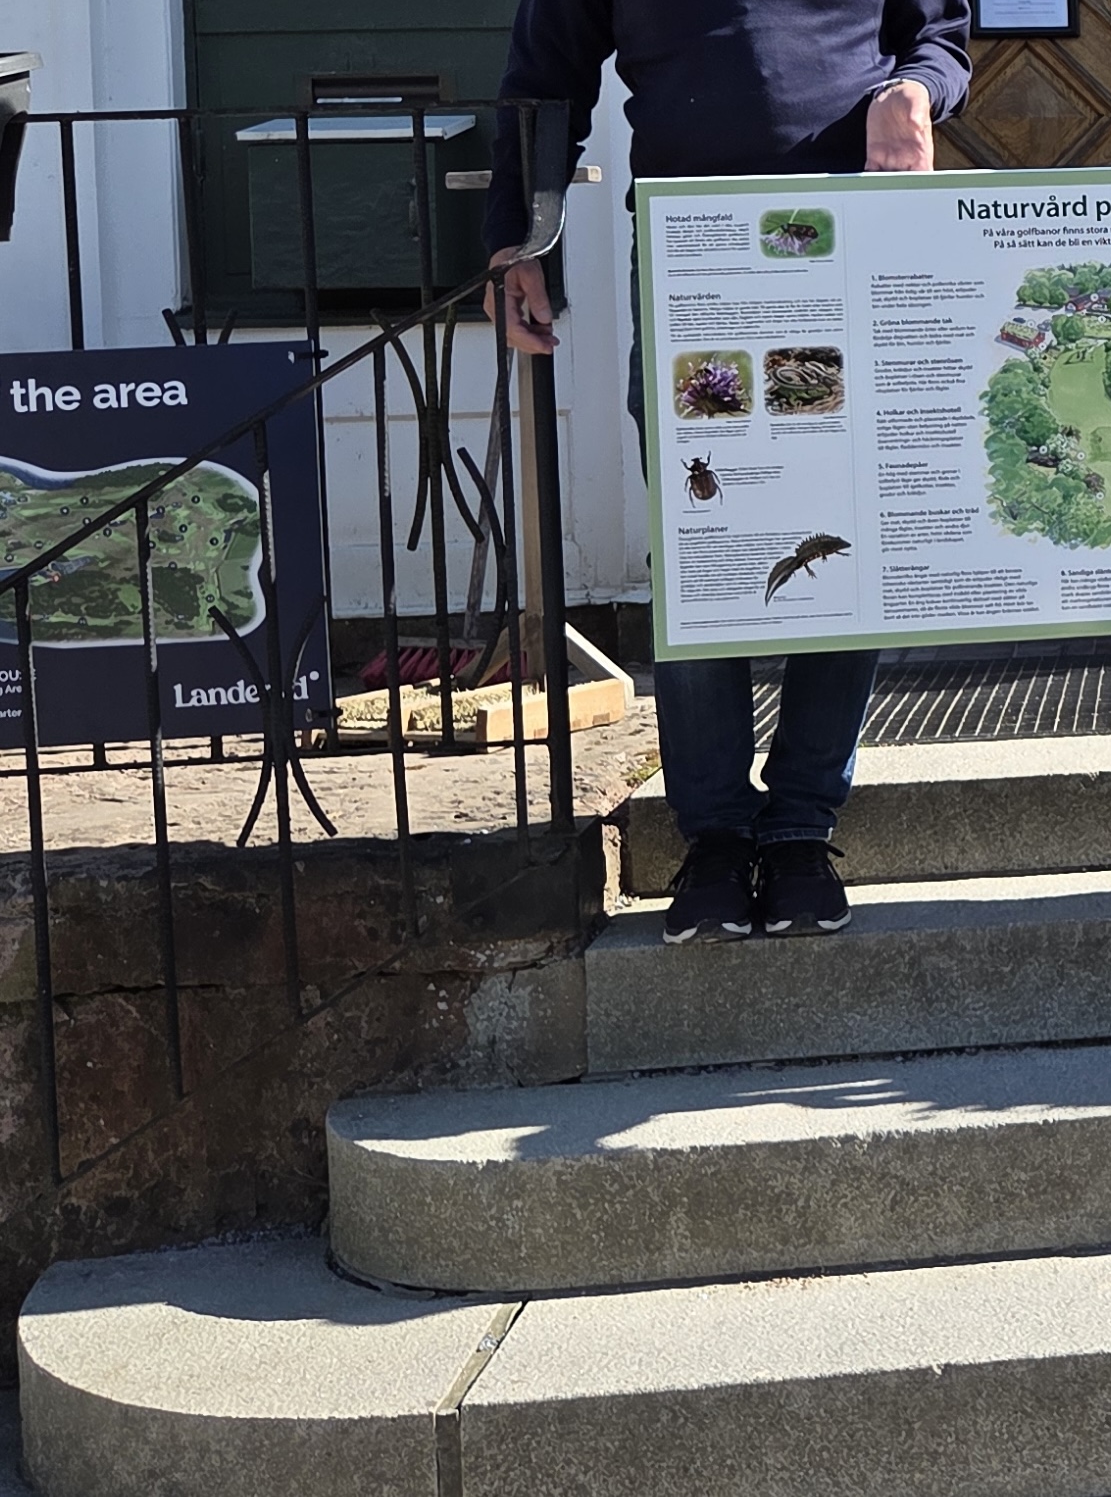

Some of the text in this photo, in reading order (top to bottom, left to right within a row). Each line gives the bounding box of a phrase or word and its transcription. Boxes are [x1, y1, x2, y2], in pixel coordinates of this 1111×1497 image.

[957, 195, 1087, 220] Naturvård
[983, 227, 994, 237] På
[995, 226, 1015, 236] våra
[1017, 226, 1061, 238] golfbanor
[1063, 225, 1084, 235] finns
[1086, 225, 1109, 235] stora
[994, 240, 1005, 249] På
[1007, 239, 1016, 248] så
[1018, 238, 1035, 248] sätt
[1037, 238, 1053, 247] kan
[1055, 238, 1067, 247] de
[1069, 237, 1080, 246] bli
[901, 317, 941, 325] blommande
[10, 379, 188, 413] the area
[951, 507, 964, 515] och
[678, 524, 729, 535] Naturplaner
[173, 675, 309, 708] Landed
